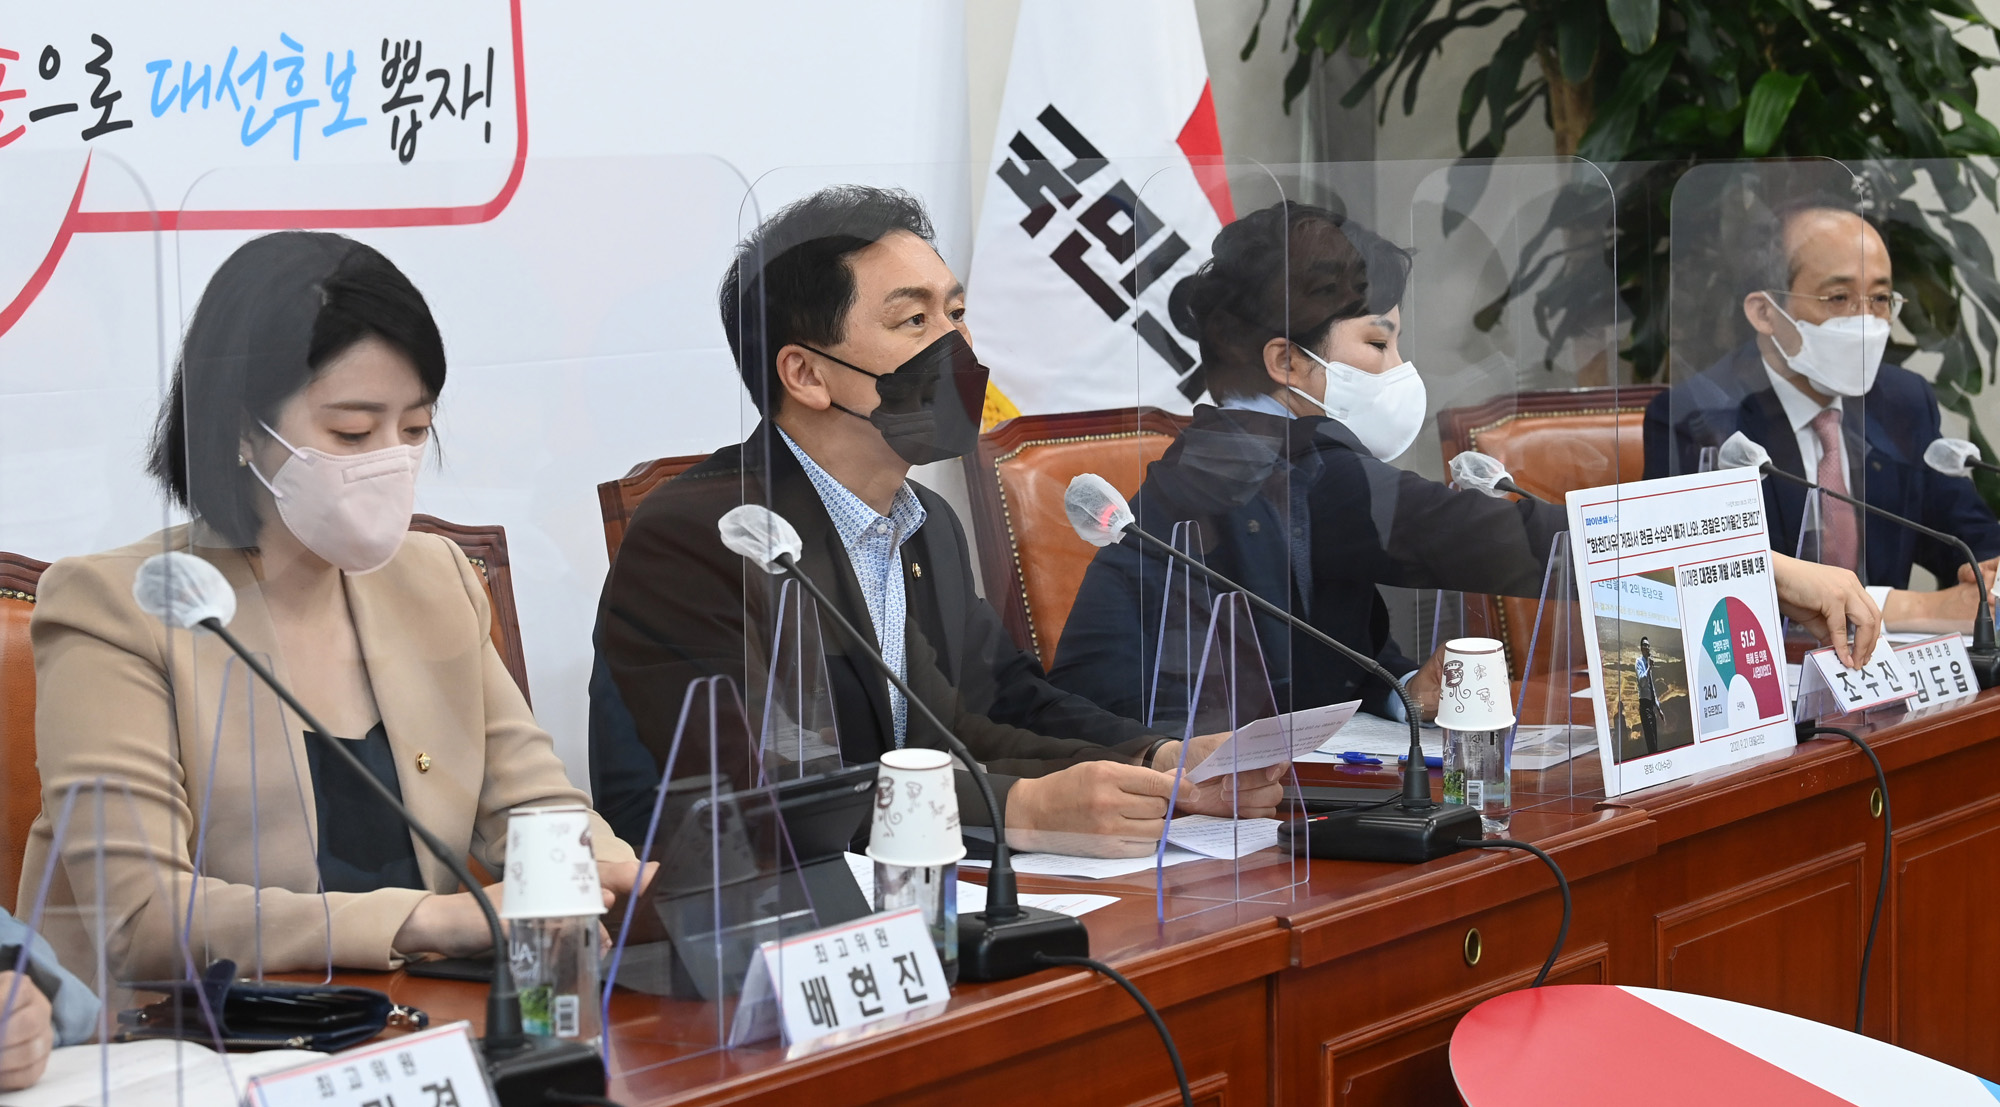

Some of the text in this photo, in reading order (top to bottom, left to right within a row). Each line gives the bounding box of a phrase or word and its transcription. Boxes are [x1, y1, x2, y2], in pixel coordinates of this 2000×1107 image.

[145, 32, 367, 161] 대선후보
[380, 38, 494, 165] 뽑자!
[1639, 527, 1654, 546] 현금
[1654, 524, 1674, 543] 수십억
[1721, 513, 1742, 533] 5개월간
[1681, 556, 1766, 588] 이재명 대장동 개발 사업 특혜 의혹
[1642, 585, 1664, 601] 분당으로
[1713, 619, 1725, 636] 24.1
[1740, 629, 1756, 649] 51.9
[1754, 651, 1760, 664] 등
[1907, 642, 1952, 665] 정책위의장
[1703, 684, 1718, 701] 24.0
[1835, 659, 1904, 703] 조수진
[1908, 660, 1969, 704] 김도읍
[1643, 763, 1655, 775] 영화
[814, 927, 890, 964] 최고위원
[800, 951, 929, 1029] 배현진
[315, 1050, 418, 1099] 최고위원
